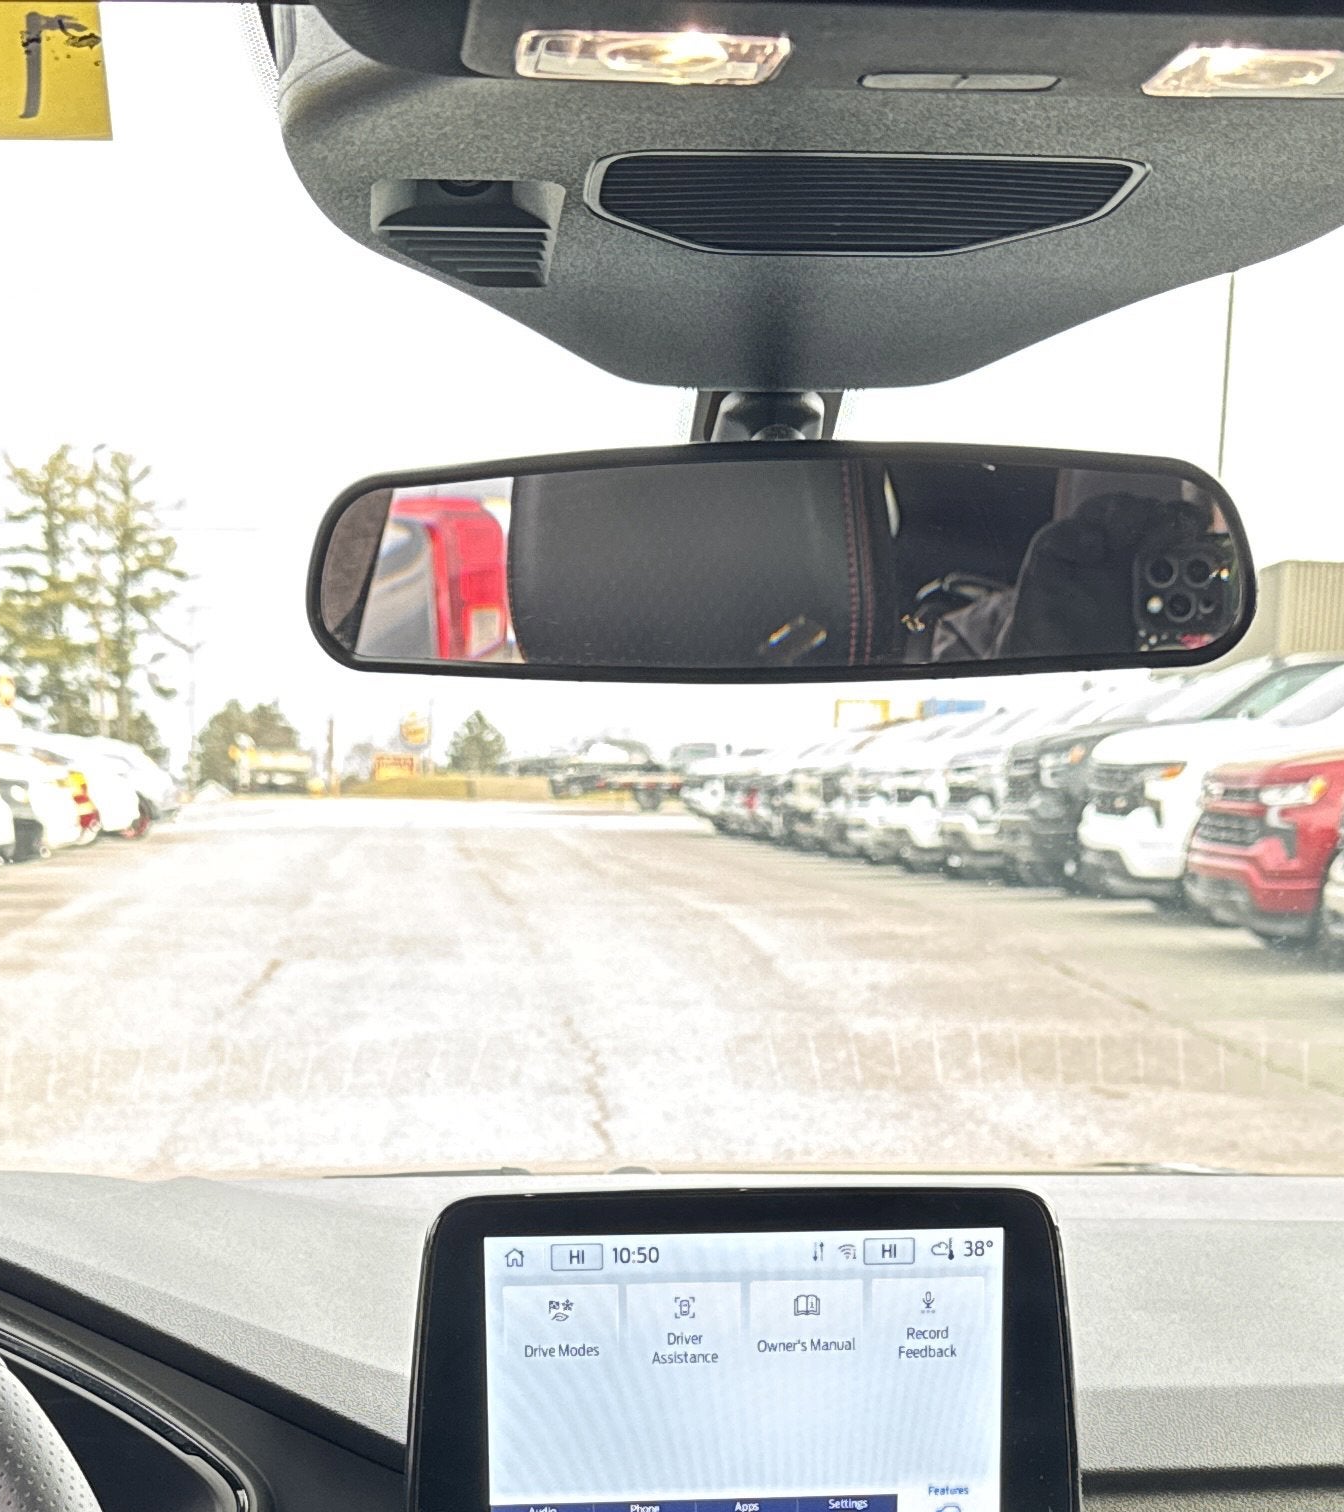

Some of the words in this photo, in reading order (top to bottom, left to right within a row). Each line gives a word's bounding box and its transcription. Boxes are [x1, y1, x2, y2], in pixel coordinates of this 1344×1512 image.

[568, 1249, 585, 1265] HI
[612, 1246, 660, 1265] 10:50
[881, 1243, 897, 1259] HI
[963, 1240, 994, 1257] 38°
[667, 1332, 704, 1346] Driver
[906, 1326, 949, 1340] Record
[524, 1344, 556, 1358] Drive
[558, 1343, 600, 1358] Modes
[757, 1338, 807, 1353] Owner's
[810, 1337, 856, 1351] Manual
[898, 1345, 958, 1359] Feedback
[652, 1351, 719, 1365] Assistance
[928, 1485, 970, 1496] Features
[828, 1498, 868, 1512] Settings
